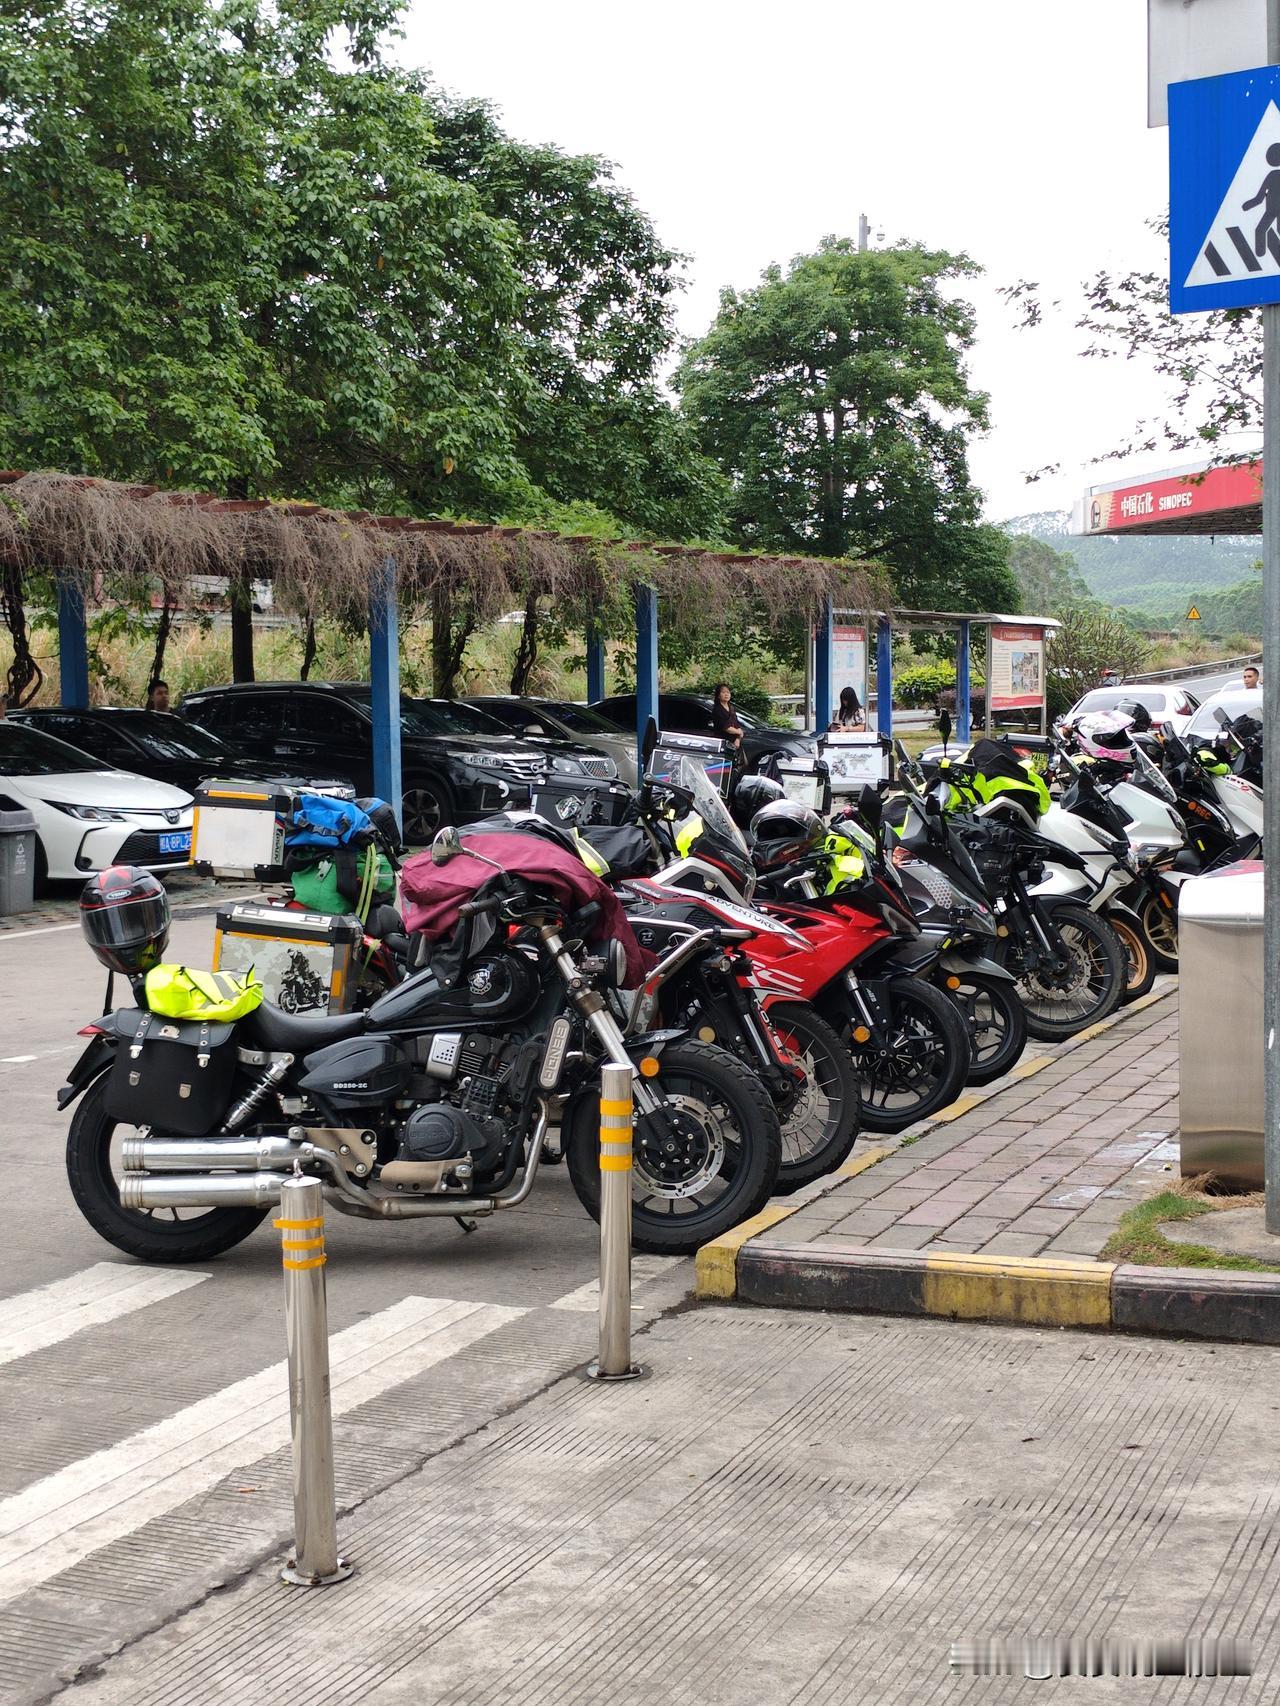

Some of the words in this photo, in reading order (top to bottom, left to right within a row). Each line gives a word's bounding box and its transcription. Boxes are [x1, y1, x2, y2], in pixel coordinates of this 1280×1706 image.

[1121, 491, 1154, 518] 中国石化
[1158, 491, 1193, 512] SINOPEC
[662, 753, 682, 762] GS
[1194, 805, 1212, 820] REC
[708, 895, 777, 931] ADVENTURE
[543, 1026, 567, 1081] BENDA
